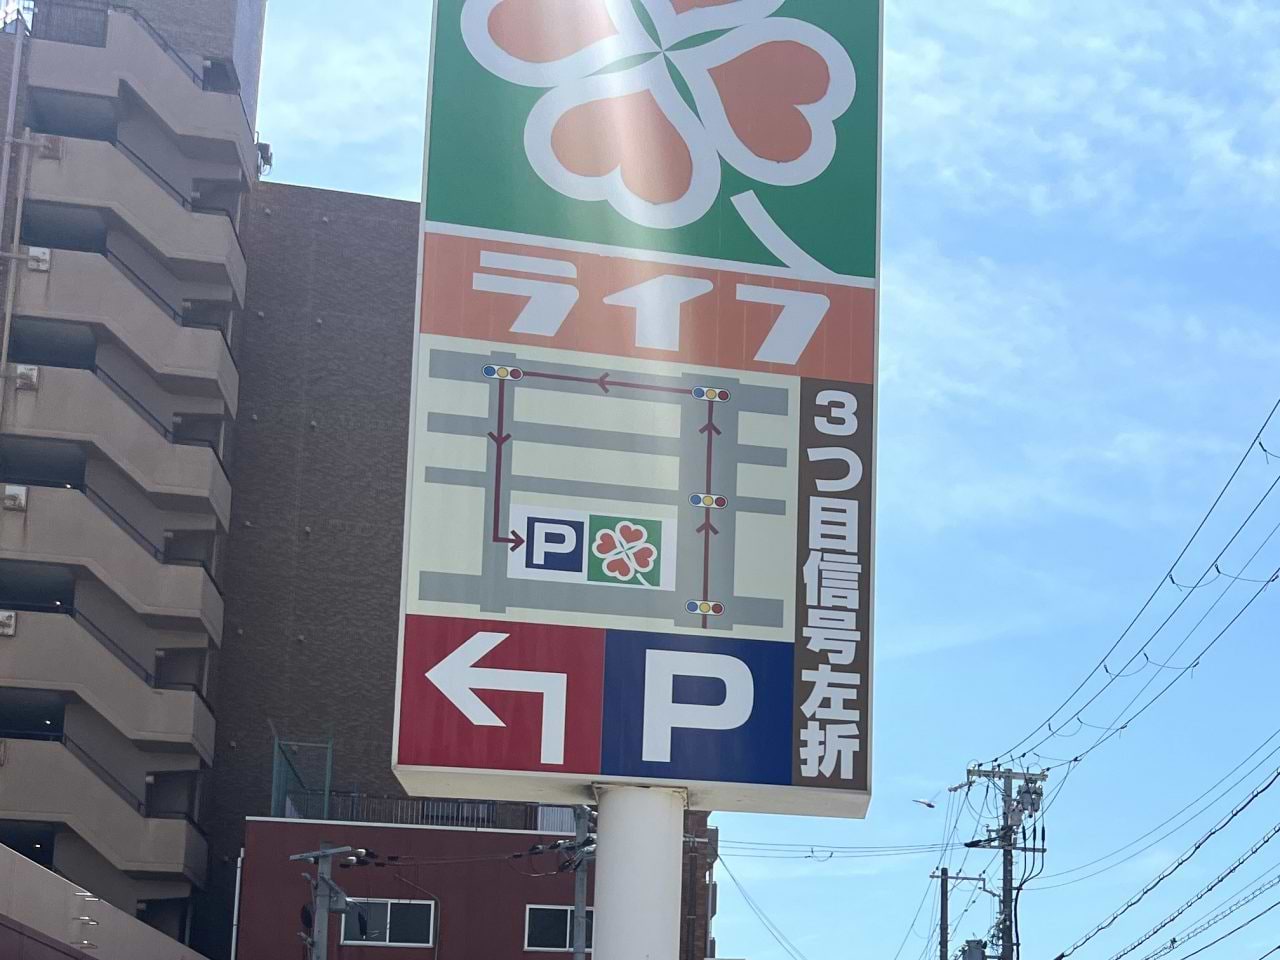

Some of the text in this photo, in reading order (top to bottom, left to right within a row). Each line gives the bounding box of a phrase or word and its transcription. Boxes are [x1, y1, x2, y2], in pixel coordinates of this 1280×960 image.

[471, 249, 831, 366] ライフ
[532, 522, 578, 566] P
[799, 389, 863, 780] 3つ目信号左折
[641, 648, 755, 763] P
